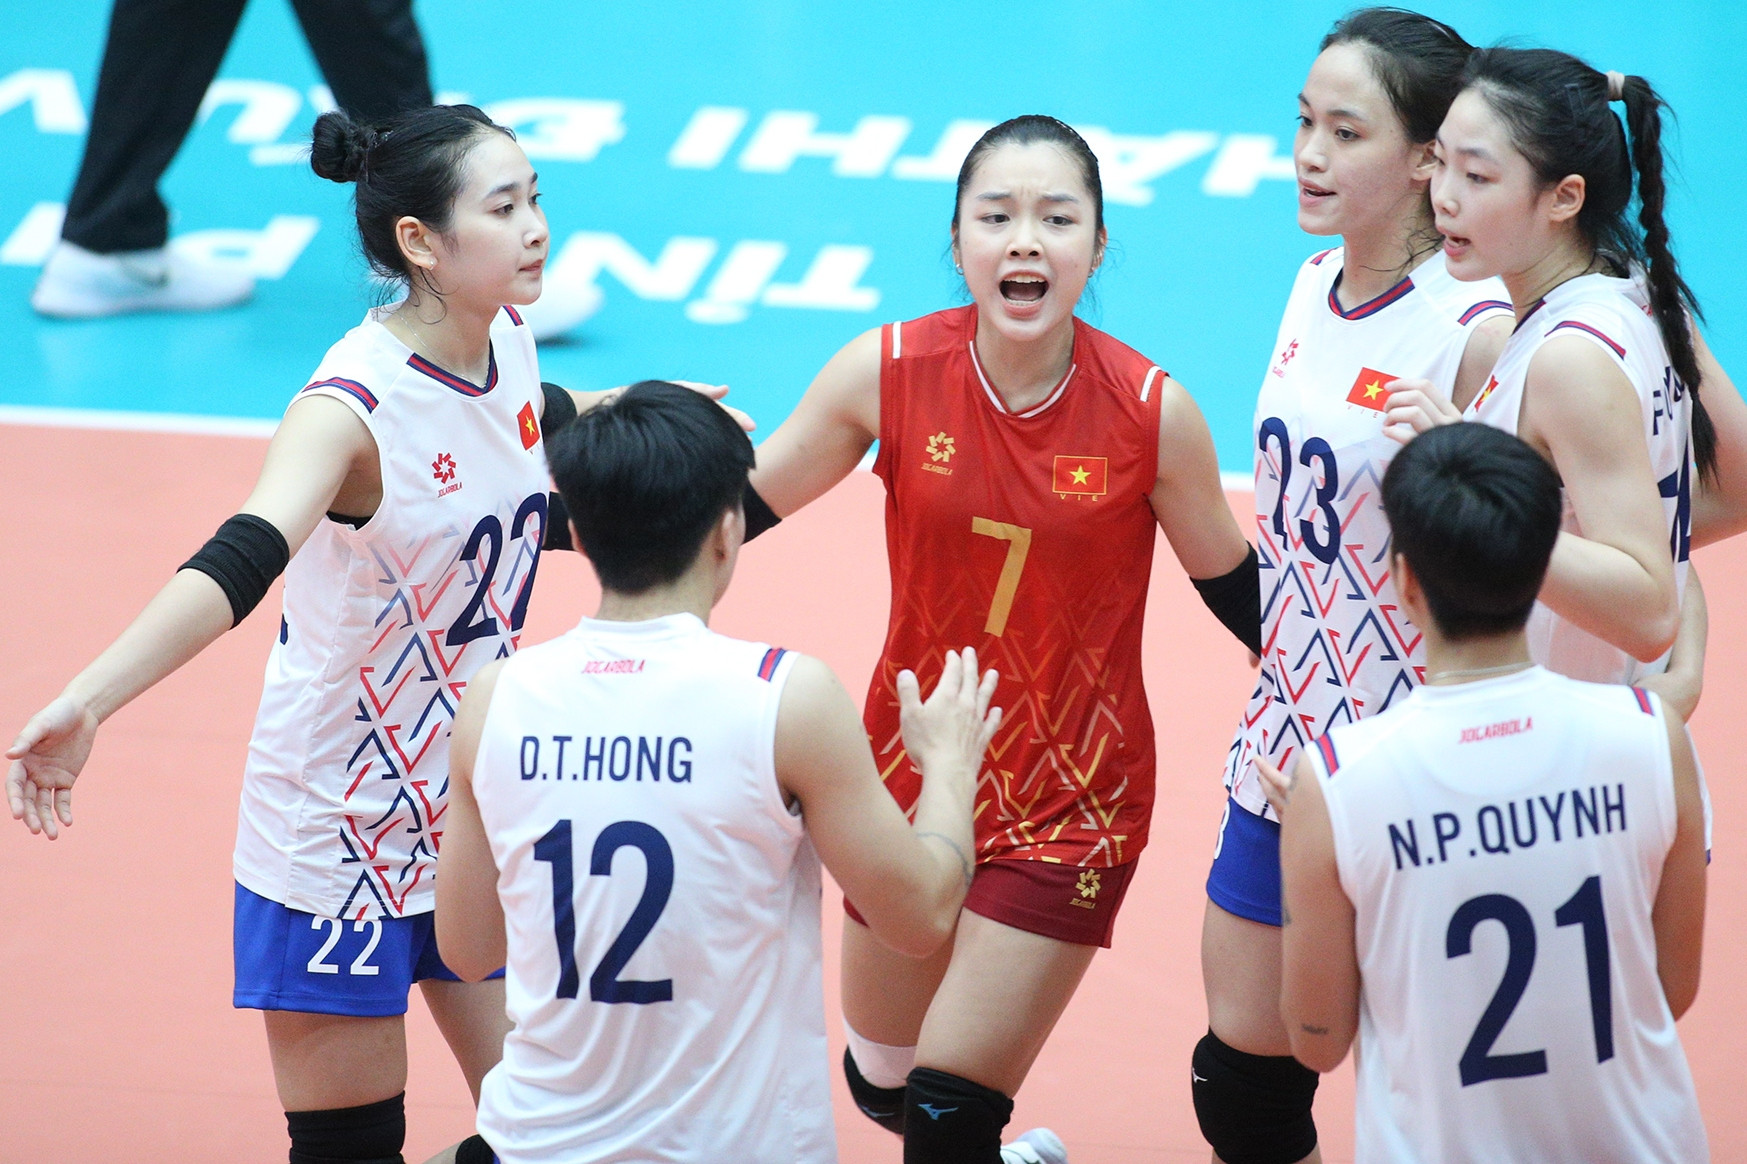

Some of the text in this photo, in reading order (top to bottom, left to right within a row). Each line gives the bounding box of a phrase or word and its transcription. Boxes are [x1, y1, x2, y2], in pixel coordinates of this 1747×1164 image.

[1259, 416, 1341, 565] 23
[446, 492, 548, 646] 22
[971, 516, 1032, 637] 7
[520, 735, 693, 783] D.T.HONG
[1388, 783, 1627, 871] N.P.QUYNH
[306, 914, 383, 976] 22
[533, 819, 674, 1005] 12
[1445, 874, 1615, 1088] 21
